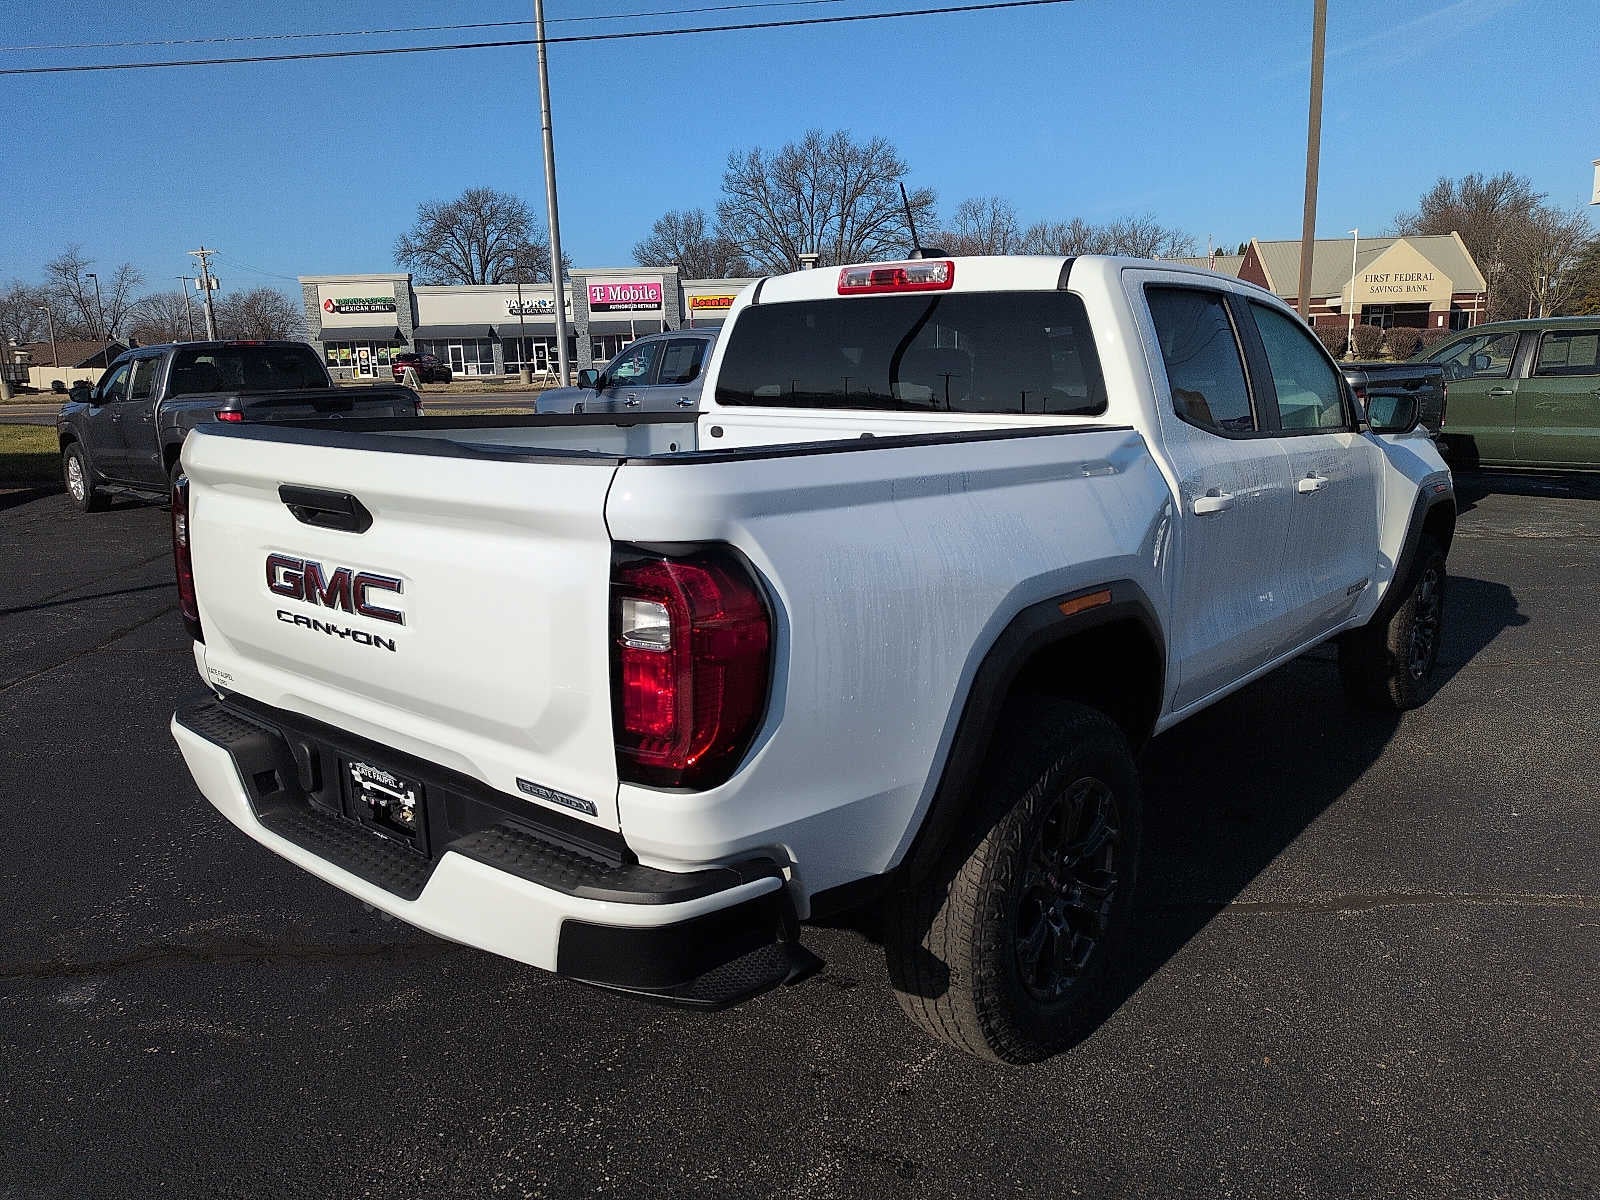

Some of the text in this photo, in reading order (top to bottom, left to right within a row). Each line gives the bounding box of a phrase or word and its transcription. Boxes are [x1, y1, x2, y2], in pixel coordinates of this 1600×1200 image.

[1364, 272, 1434, 283] FIRST FEDERAL
[1369, 284, 1428, 294] SAVINGS BANK
[265, 552, 406, 627] GMC
[276, 609, 397, 652] CANYON
